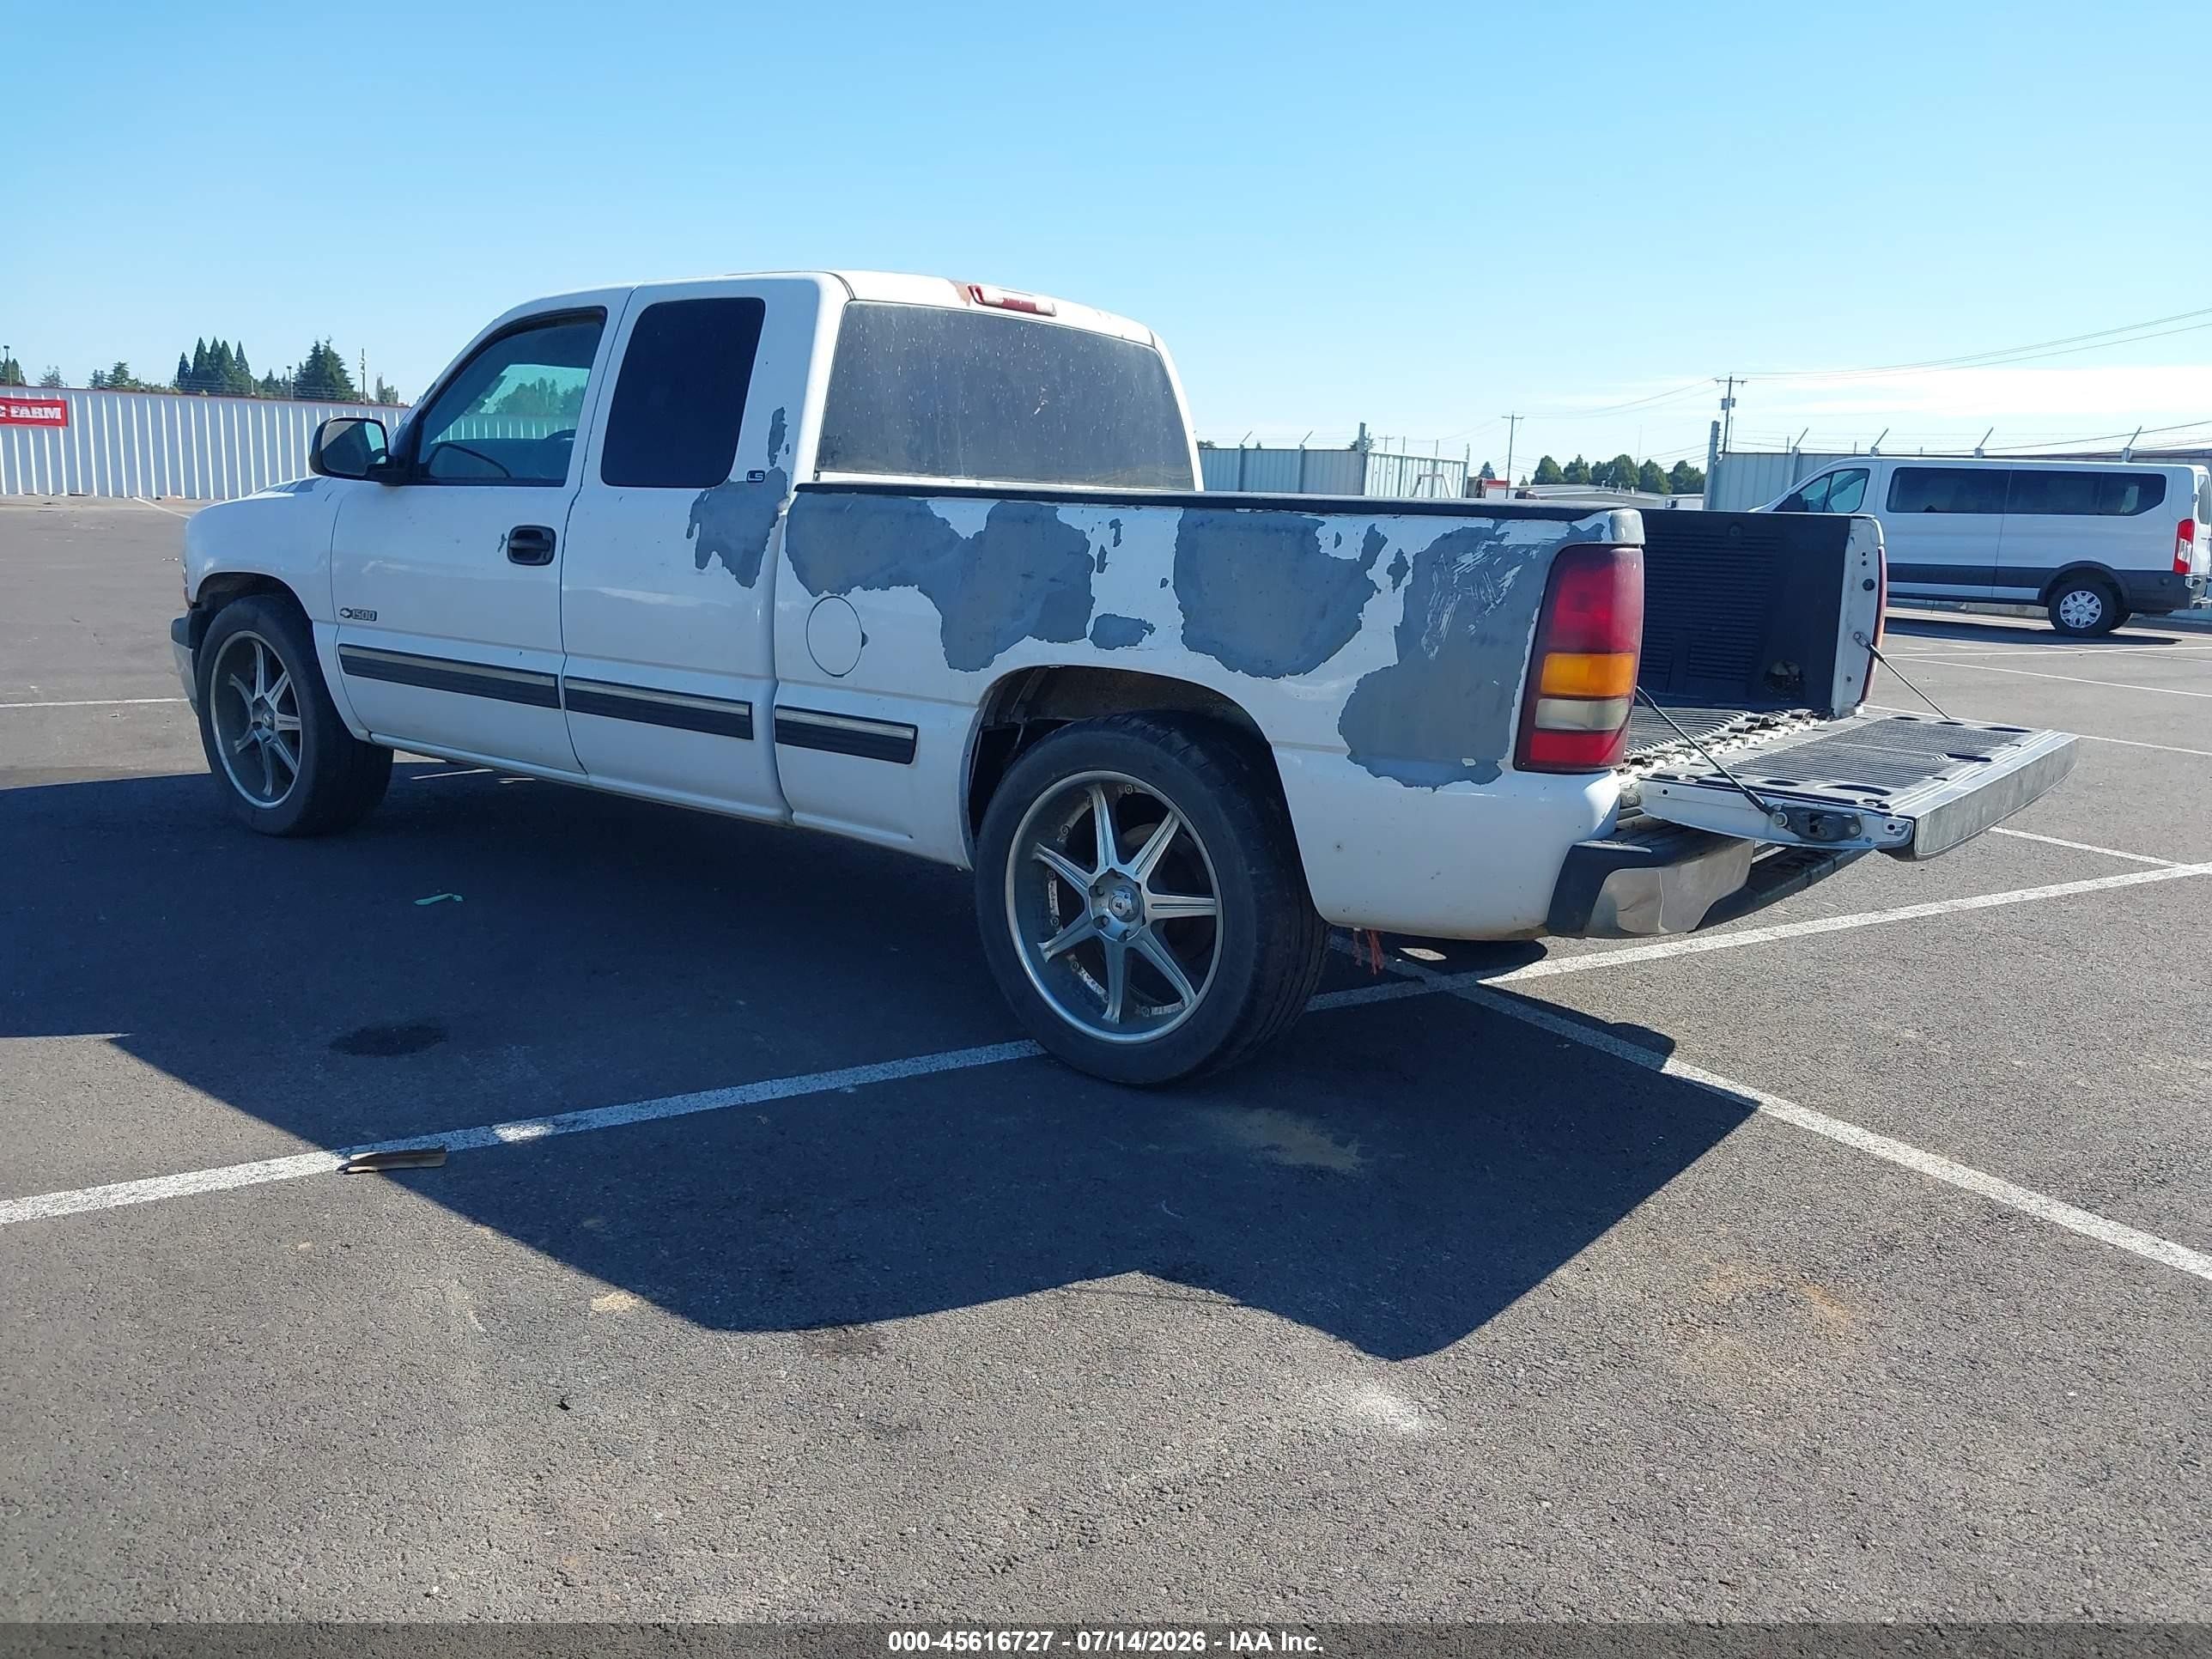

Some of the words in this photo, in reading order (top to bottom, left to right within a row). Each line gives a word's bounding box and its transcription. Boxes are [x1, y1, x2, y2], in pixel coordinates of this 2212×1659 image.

[10, 405, 62, 419] FARM
[747, 471, 764, 482] LS
[352, 610, 376, 621] 1500
